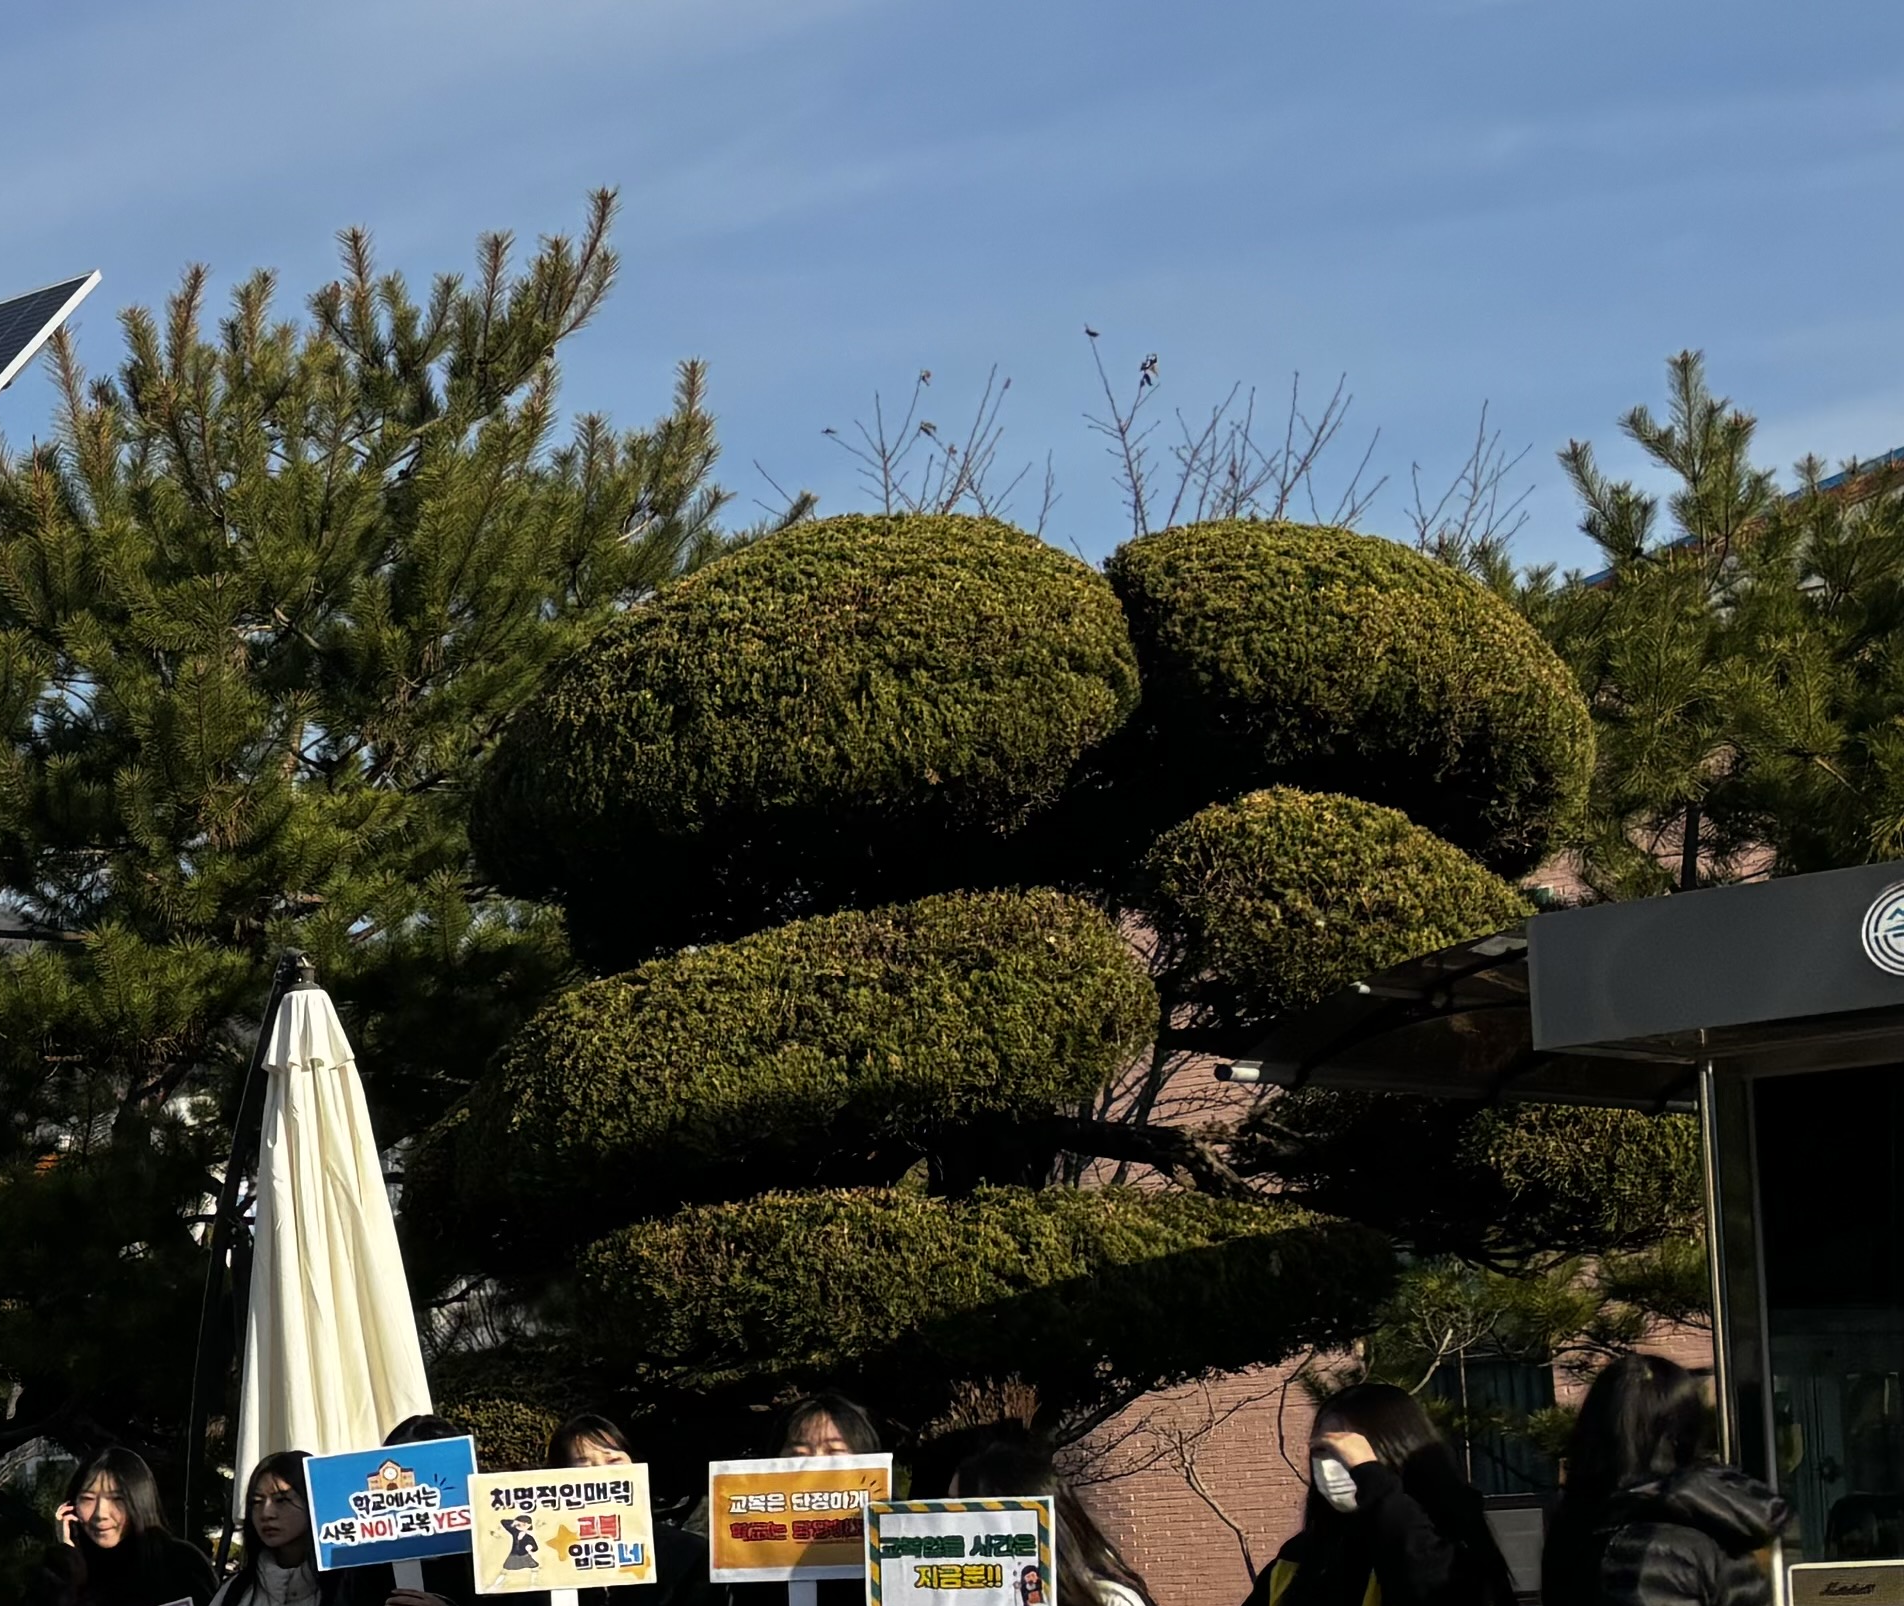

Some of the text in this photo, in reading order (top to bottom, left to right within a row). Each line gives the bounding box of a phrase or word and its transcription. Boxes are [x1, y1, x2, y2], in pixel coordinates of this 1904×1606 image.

[352, 1486, 438, 1516] 학교에서는
[728, 1489, 869, 1514] 교복은 단정하게
[323, 1521, 357, 1542] 사복
[400, 1511, 432, 1533] 교복
[433, 1509, 471, 1530] YES
[568, 1541, 644, 1570] 입은 너
[969, 1533, 1037, 1558] 시간은
[914, 1563, 1003, 1590] 지금뿐!!
